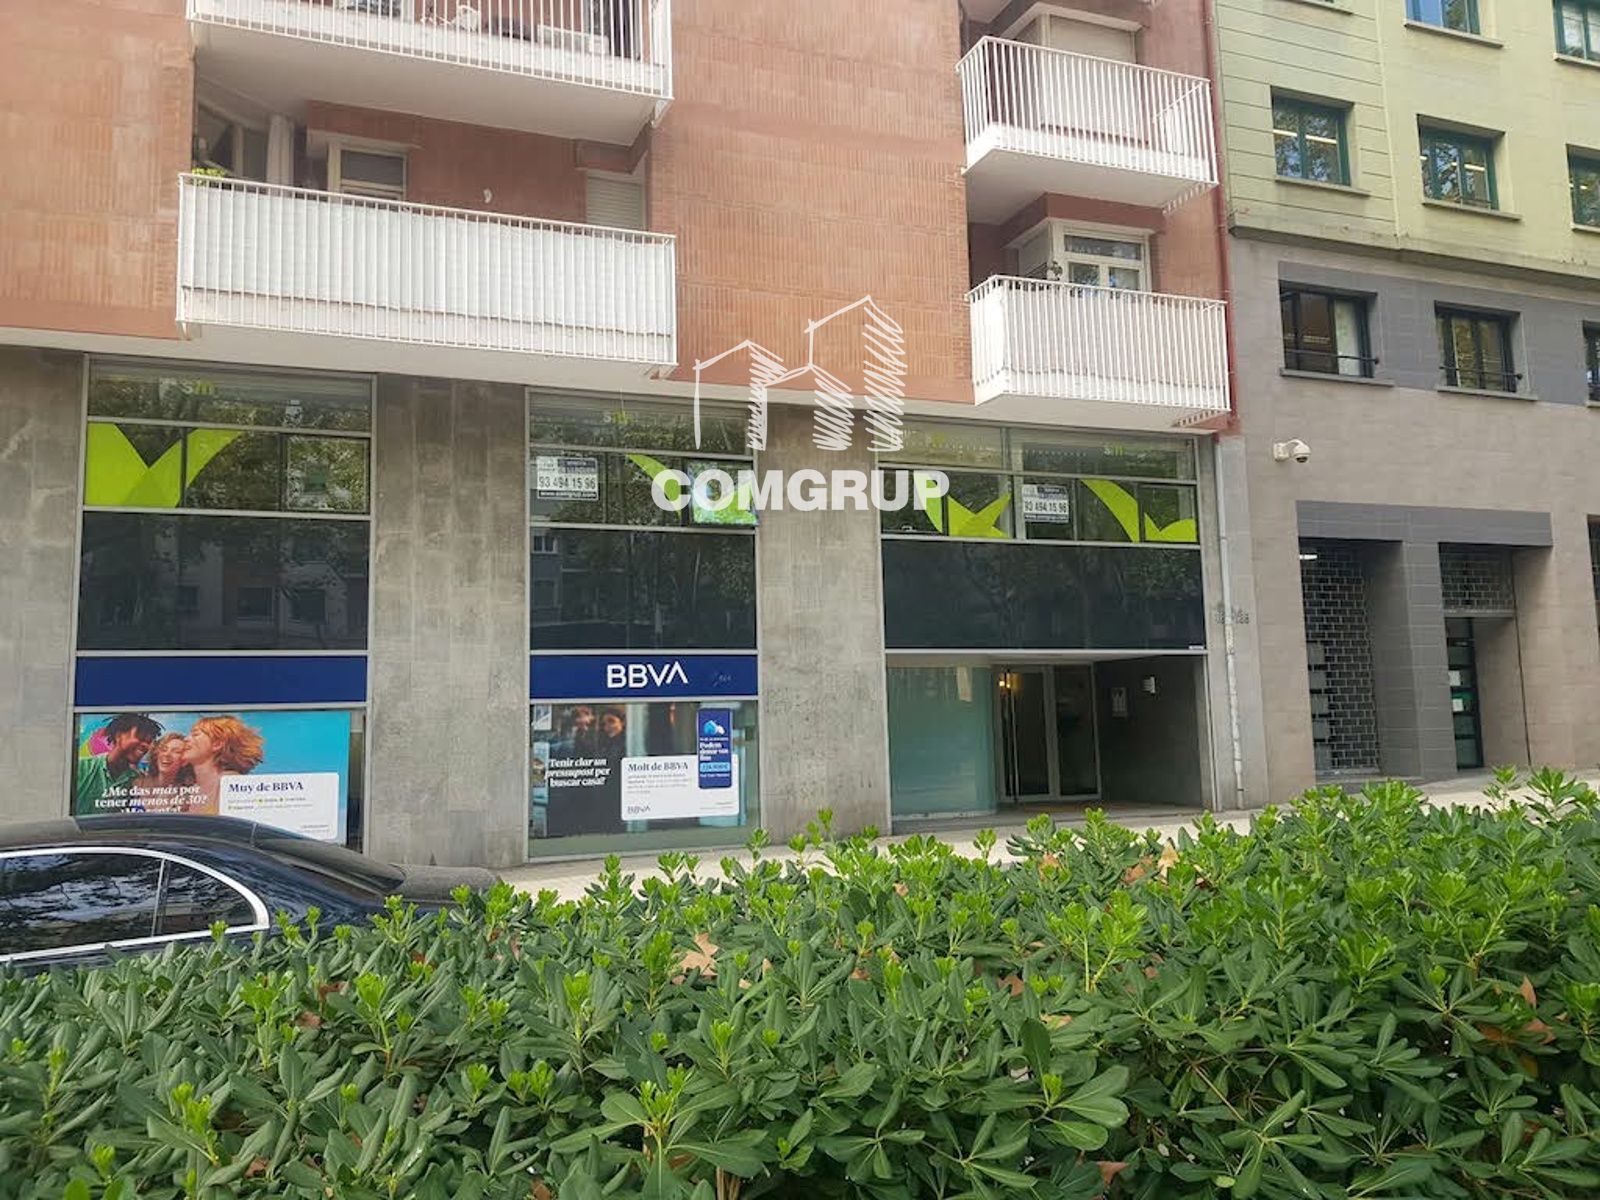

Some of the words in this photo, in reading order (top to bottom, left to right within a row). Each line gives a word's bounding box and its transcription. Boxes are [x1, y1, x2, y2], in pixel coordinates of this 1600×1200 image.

[539, 476, 551, 488] 93
[572, 477, 583, 489] 15
[606, 661, 689, 689] BBVA
[550, 758, 573, 767] Tenir
[574, 758, 593, 767] clar
[627, 763, 650, 772] Molt
[651, 763, 662, 771] de
[663, 762, 689, 770] BBVA
[595, 768, 611, 777] per
[102, 787, 127, 797] ¿Me
[129, 786, 152, 796] das
[152, 785, 178, 794] más
[179, 784, 201, 796] por
[228, 784, 255, 793] Muy
[256, 783, 271, 791] de
[272, 782, 304, 791] BBVA
[94, 799, 128, 808] tener
[128, 797, 168, 807] menos
[169, 796, 186, 805] de
[186, 794, 208, 805] 30?
